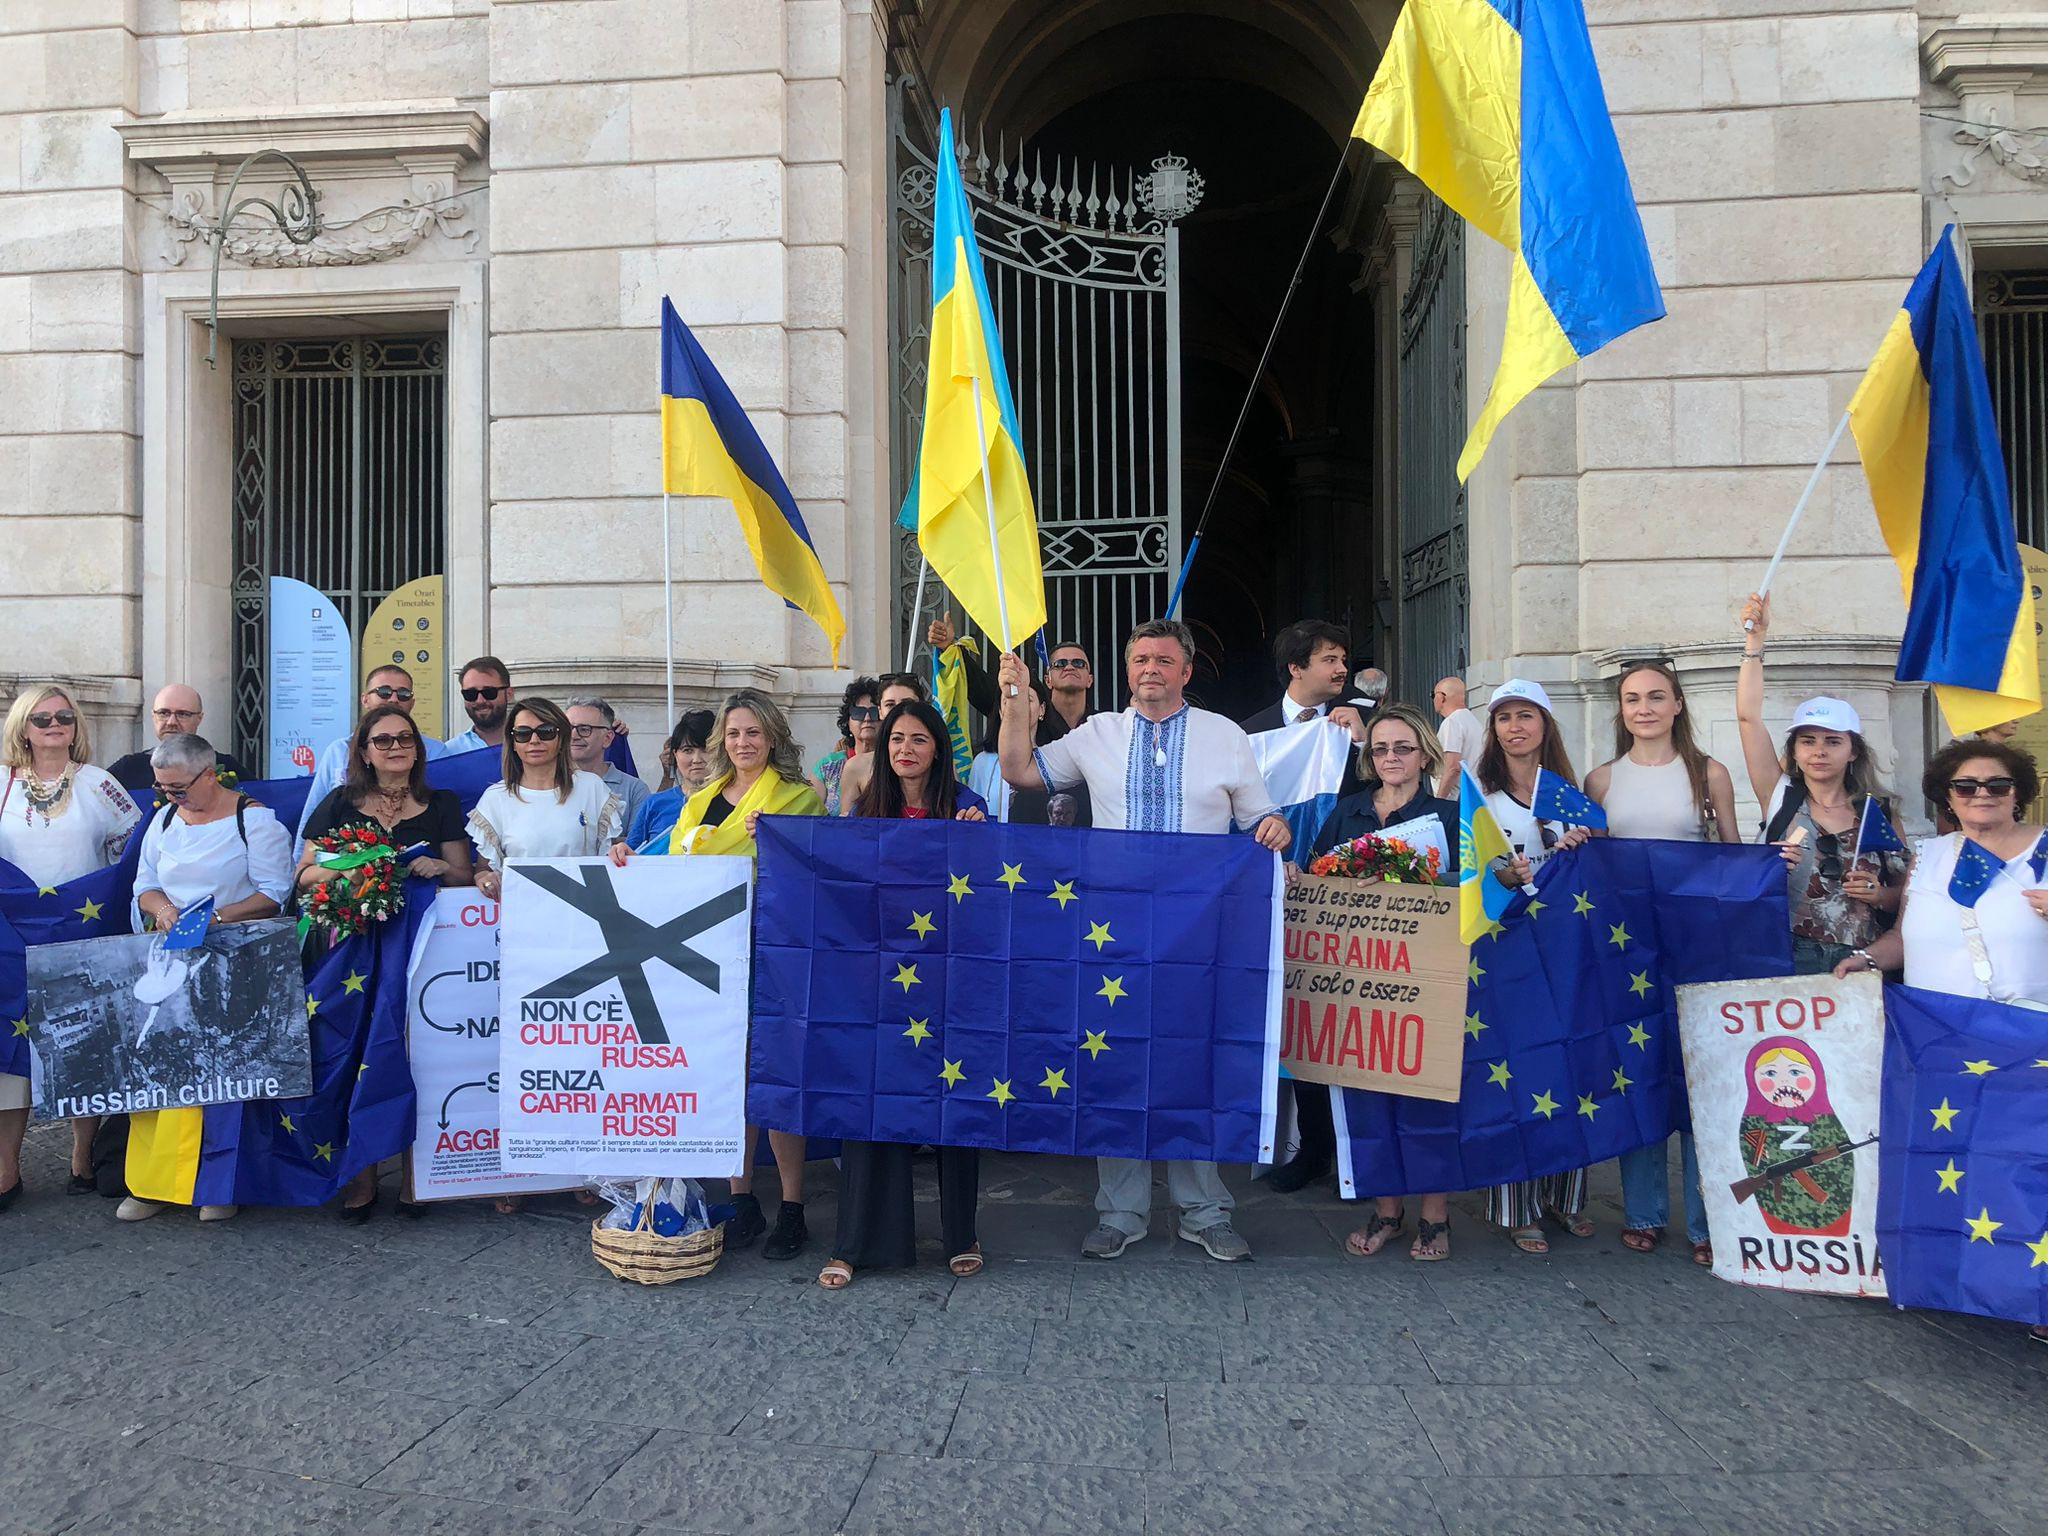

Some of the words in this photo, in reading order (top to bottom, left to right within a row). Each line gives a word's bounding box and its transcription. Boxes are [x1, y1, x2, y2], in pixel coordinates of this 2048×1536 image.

[294, 748, 312, 764] RE
[1330, 890, 1382, 910] essere
[1386, 896, 1451, 916] ucraino
[1316, 910, 1419, 934] supportare
[1285, 928, 1412, 974] UCRAINA
[1309, 972, 1354, 995] solo
[1360, 980, 1420, 1002] essere
[521, 1001, 576, 1022] NON
[583, 994, 623, 1022] C'È
[1720, 996, 1836, 1034] STOP
[520, 1024, 638, 1045] CULTURA
[602, 1046, 688, 1068] RUSSA
[520, 1070, 604, 1091] SENZA
[57, 1084, 168, 1118] russian
[179, 1076, 280, 1105] culture
[520, 1092, 596, 1114] CARRI
[602, 1092, 698, 1114] ARMATI
[603, 1116, 676, 1136] RUSSI
[1777, 1124, 1812, 1151] Z
